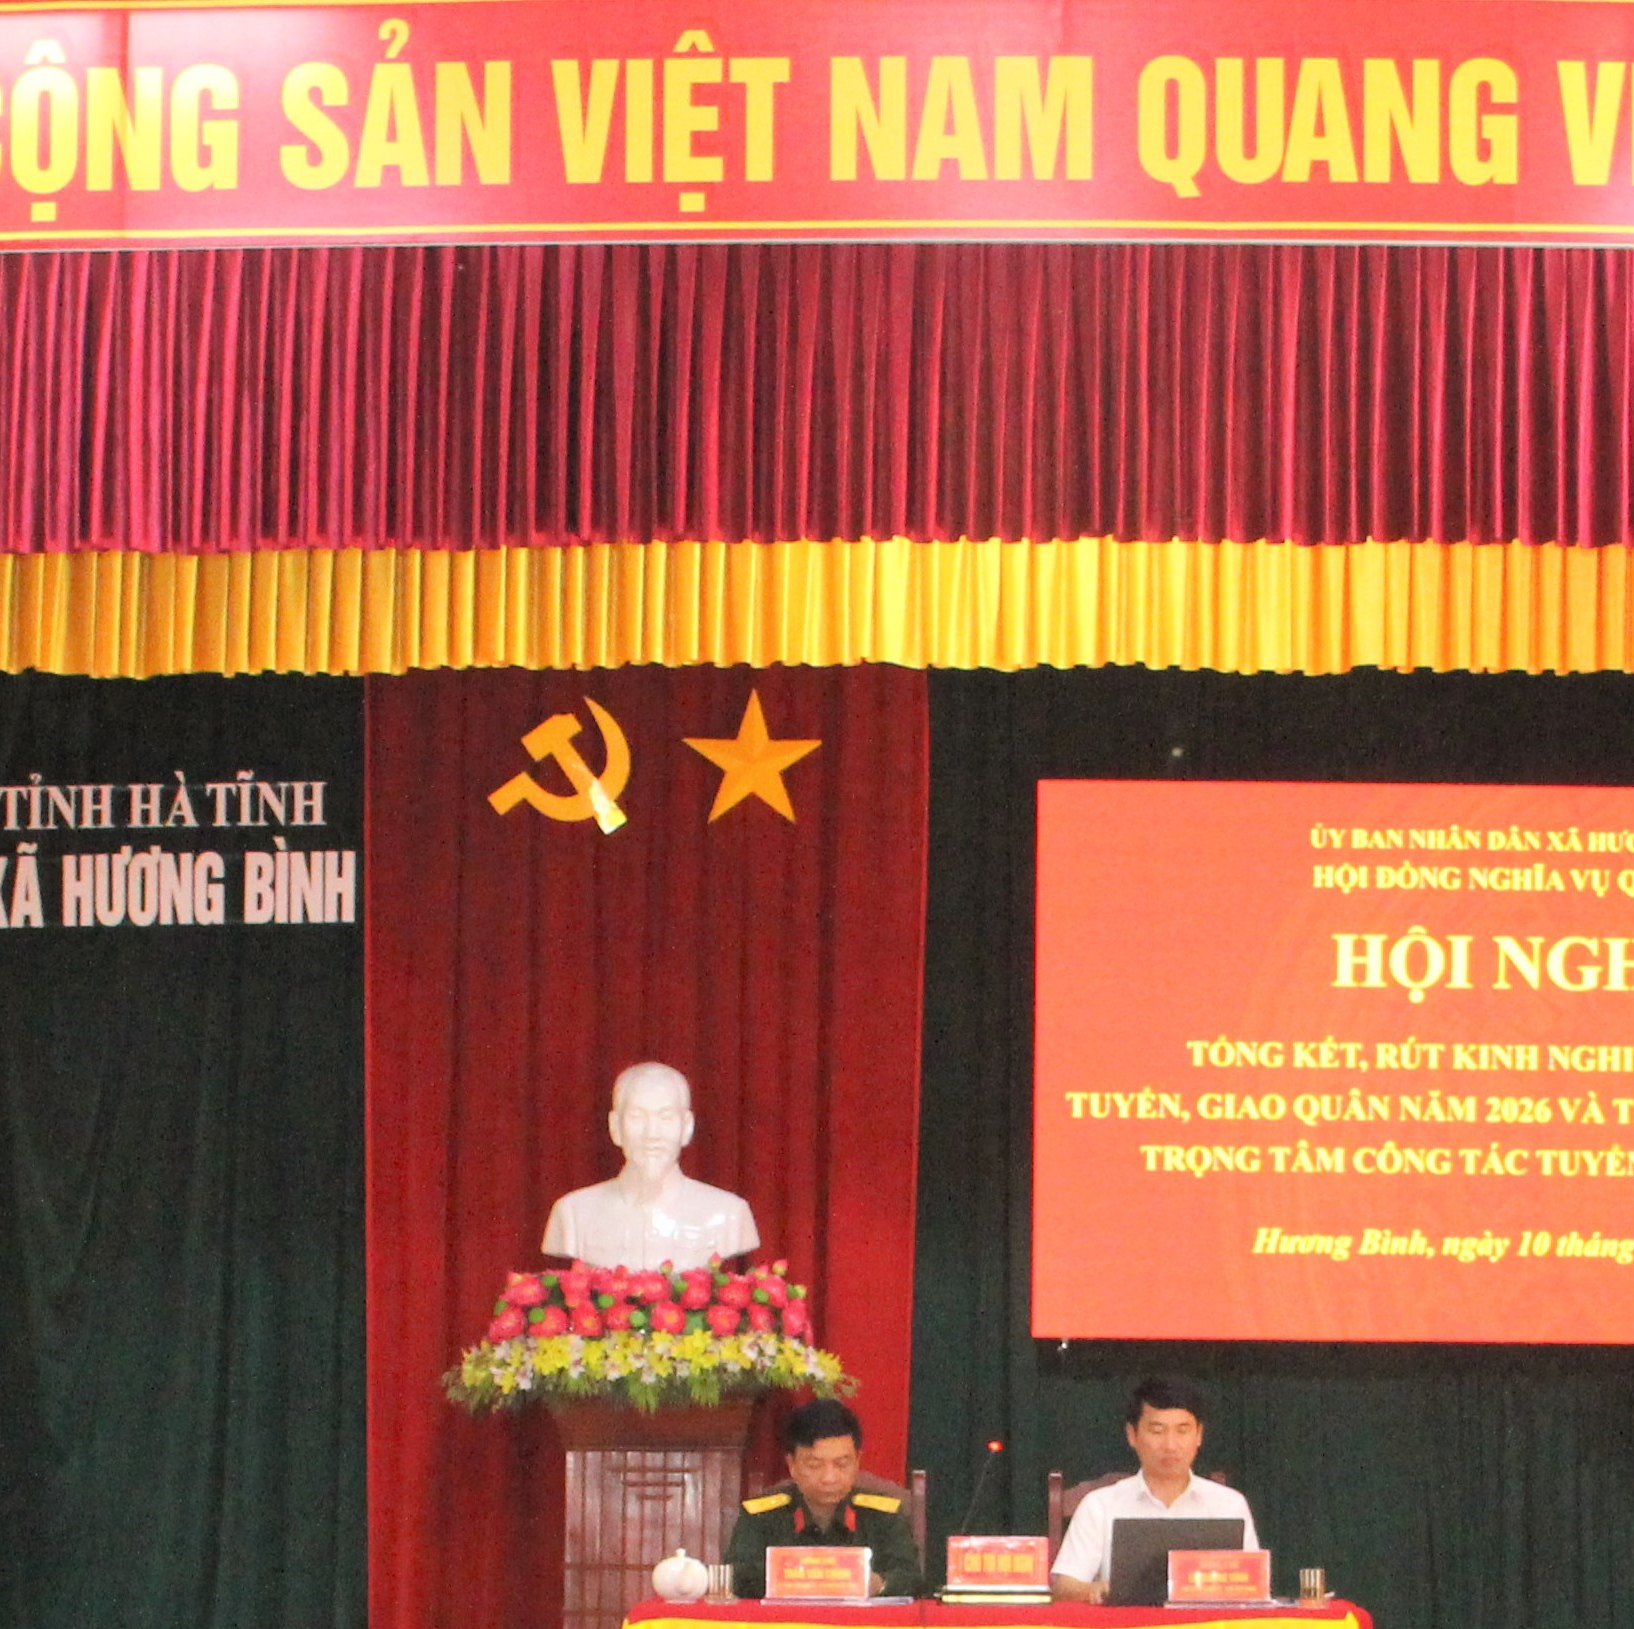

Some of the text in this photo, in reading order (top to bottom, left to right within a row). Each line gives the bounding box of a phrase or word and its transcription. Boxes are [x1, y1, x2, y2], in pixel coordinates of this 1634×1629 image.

[279, 18, 510, 190] SẢN
[552, 31, 789, 211] VIỆT
[831, 57, 1092, 182] NAM
[1136, 54, 1519, 197] QUANG
[127, 771, 199, 829] HÀ
[205, 770, 327, 827] TĨNH
[1351, 828, 1404, 849] BAN
[1409, 824, 1481, 850] NHÂN
[1487, 825, 1541, 851] DÂN
[1547, 827, 1583, 852] XÃ
[61, 845, 225, 926] HƯƠNG
[244, 836, 355, 924] BÌNH
[1313, 863, 1369, 894] HỘI
[1569, 869, 1610, 897] VỤ
[1330, 925, 1473, 1004] HỘI
[1375, 1036, 1446, 1070] RÚT
[1452, 1044, 1539, 1071] KINH
[1197, 1093, 1288, 1121] GIAO
[1292, 1087, 1391, 1127] QUÂN
[1399, 1090, 1477, 1123] NĂM
[1485, 1096, 1553, 1123] 2026
[1557, 1091, 1606, 1125] VÀ
[1140, 1145, 1262, 1178] TRỌNG
[1267, 1139, 1346, 1174] TÂM
[1352, 1140, 1453, 1175] CÔNG
[1458, 1142, 1529, 1176] TÁC
[1441, 1230, 1511, 1264] ngày
[1517, 1230, 1552, 1257] 10
